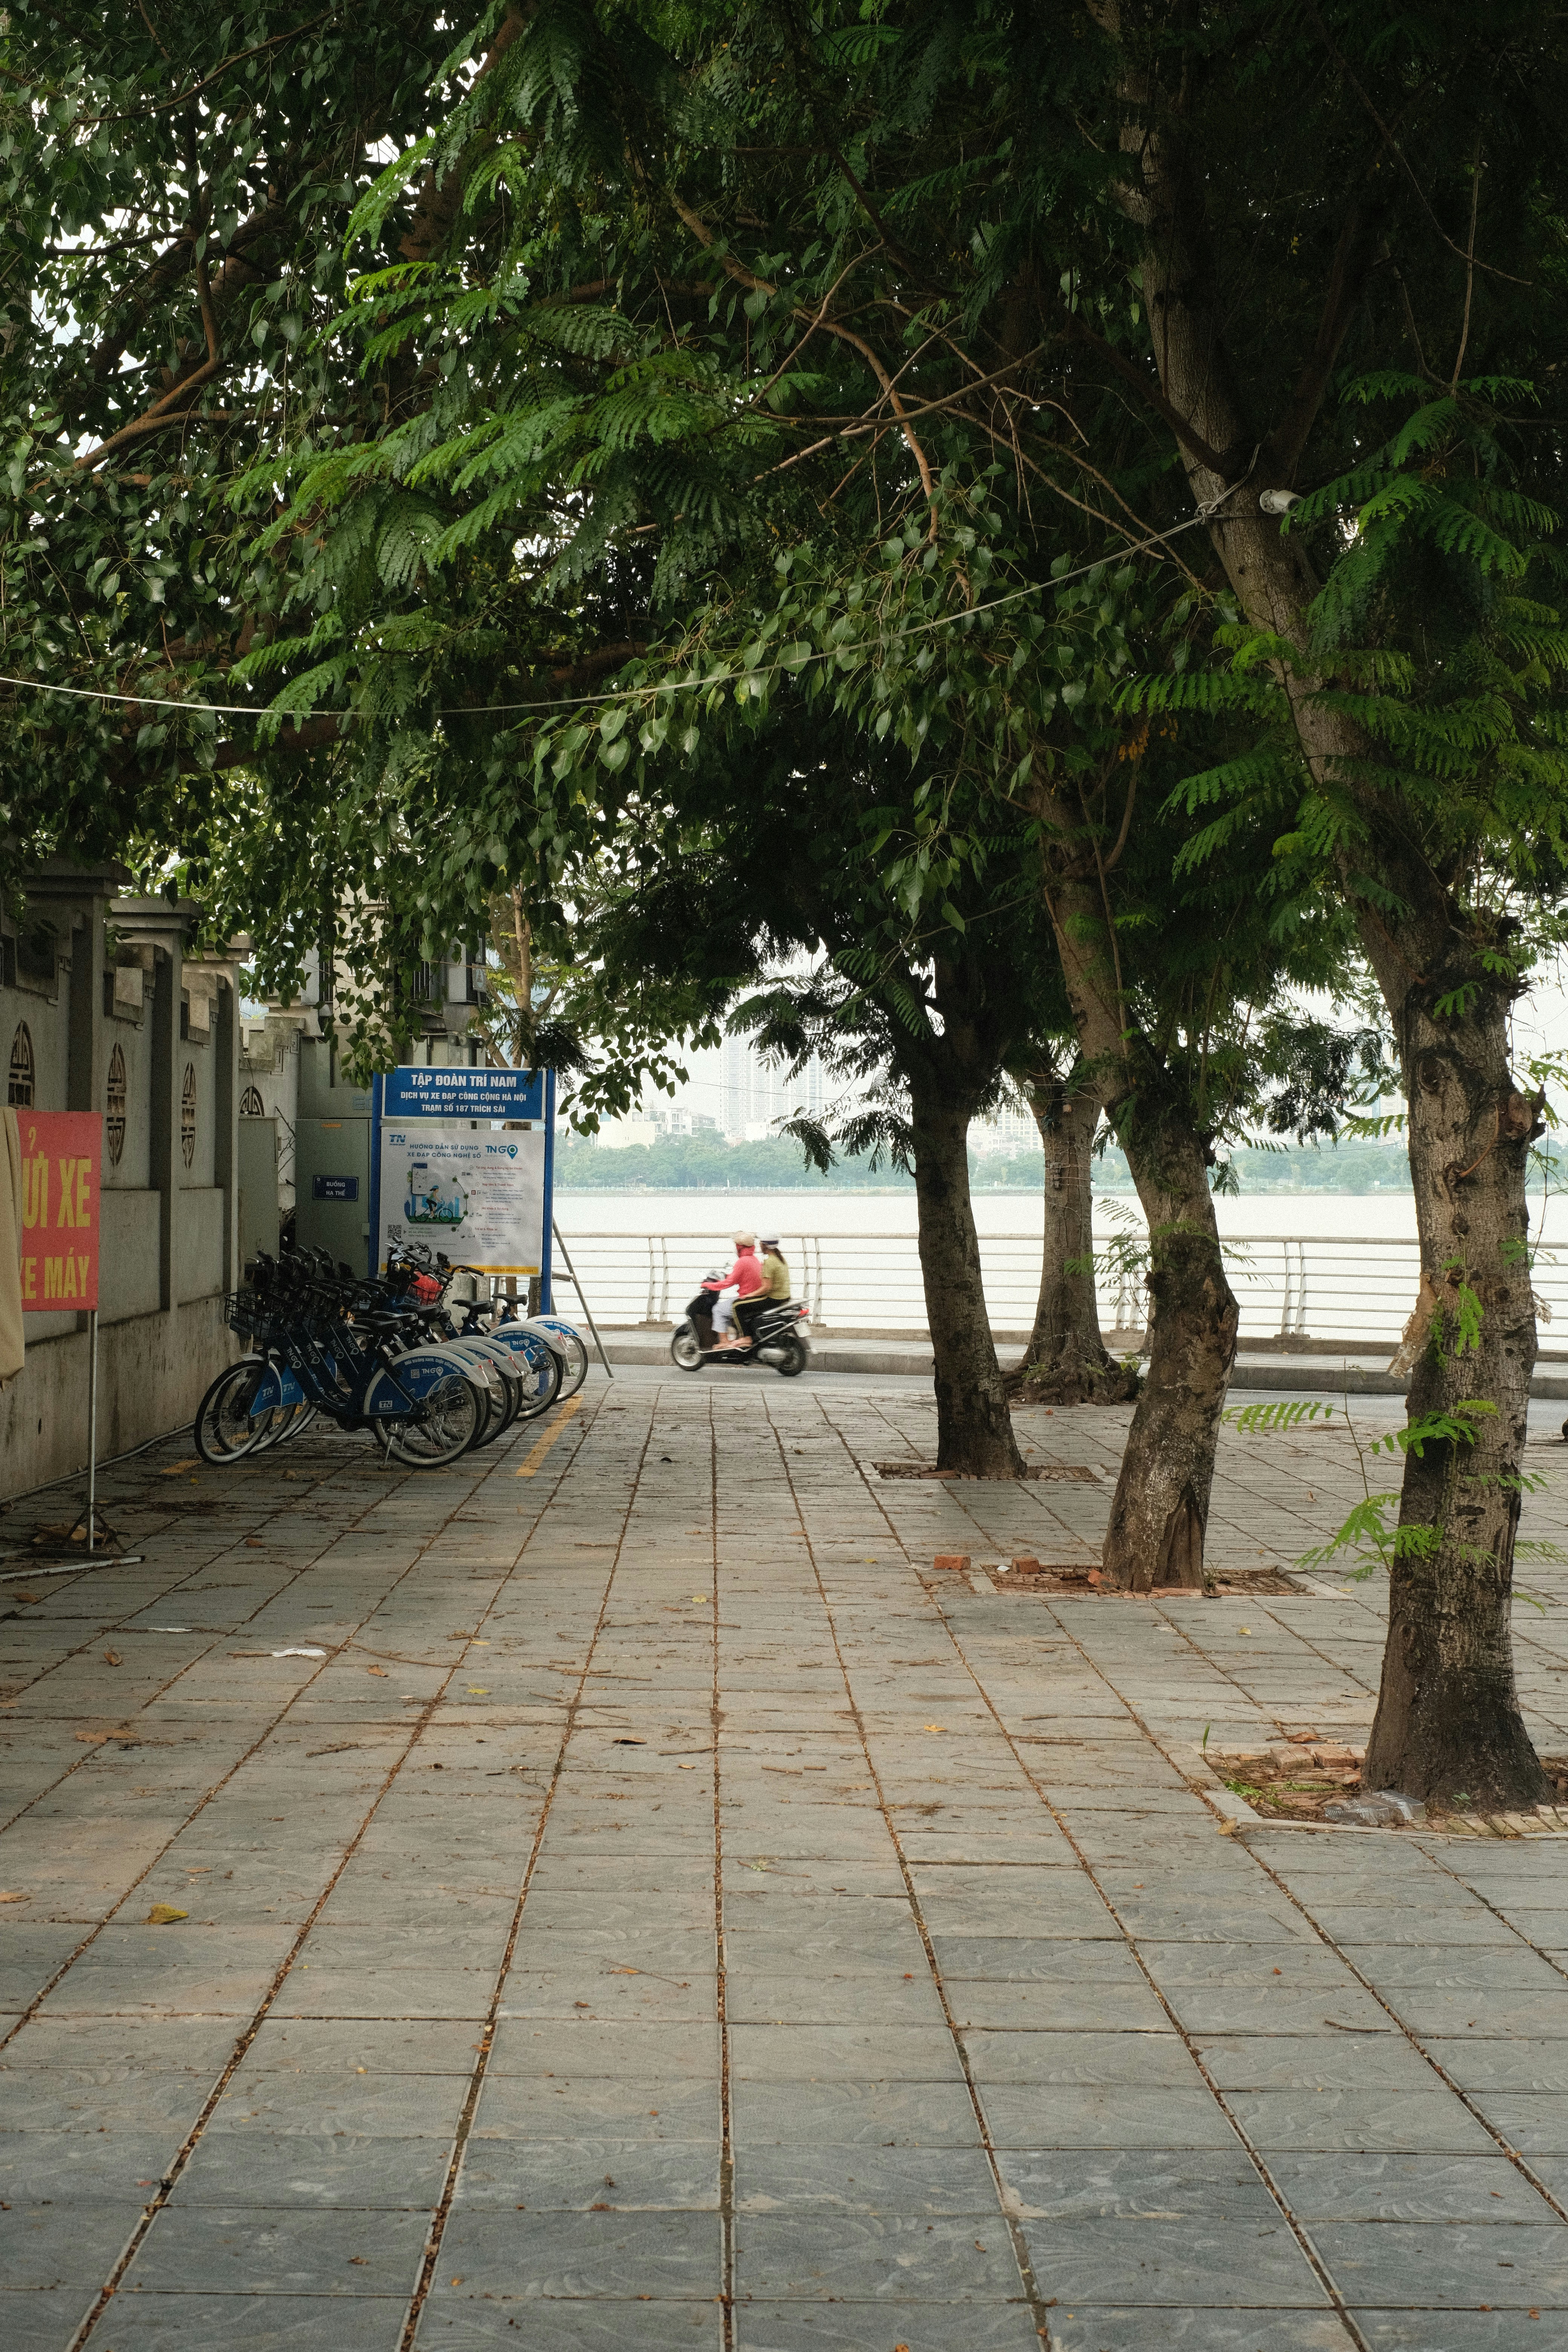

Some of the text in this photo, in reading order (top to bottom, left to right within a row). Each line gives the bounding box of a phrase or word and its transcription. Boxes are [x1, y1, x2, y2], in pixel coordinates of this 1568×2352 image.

[411, 1073, 517, 1088] TẬP ĐOÀN TRÍ NAM
[401, 1092, 418, 1100] DỊCH
[420, 1092, 429, 1101] VỤ
[442, 1093, 456, 1101] ĐẠP
[458, 1092, 478, 1100] CÔNG
[480, 1092, 500, 1102] CỘNG
[502, 1092, 512, 1101] HÀ
[514, 1093, 527, 1102] NỘI
[421, 1104, 442, 1113] TRẠM
[443, 1103, 454, 1112] SỐ
[22, 1126, 92, 1229] ỬI XE
[44, 1247, 90, 1299] MÁY
[262, 1386, 274, 1397] TN
[283, 1382, 295, 1392] TN
